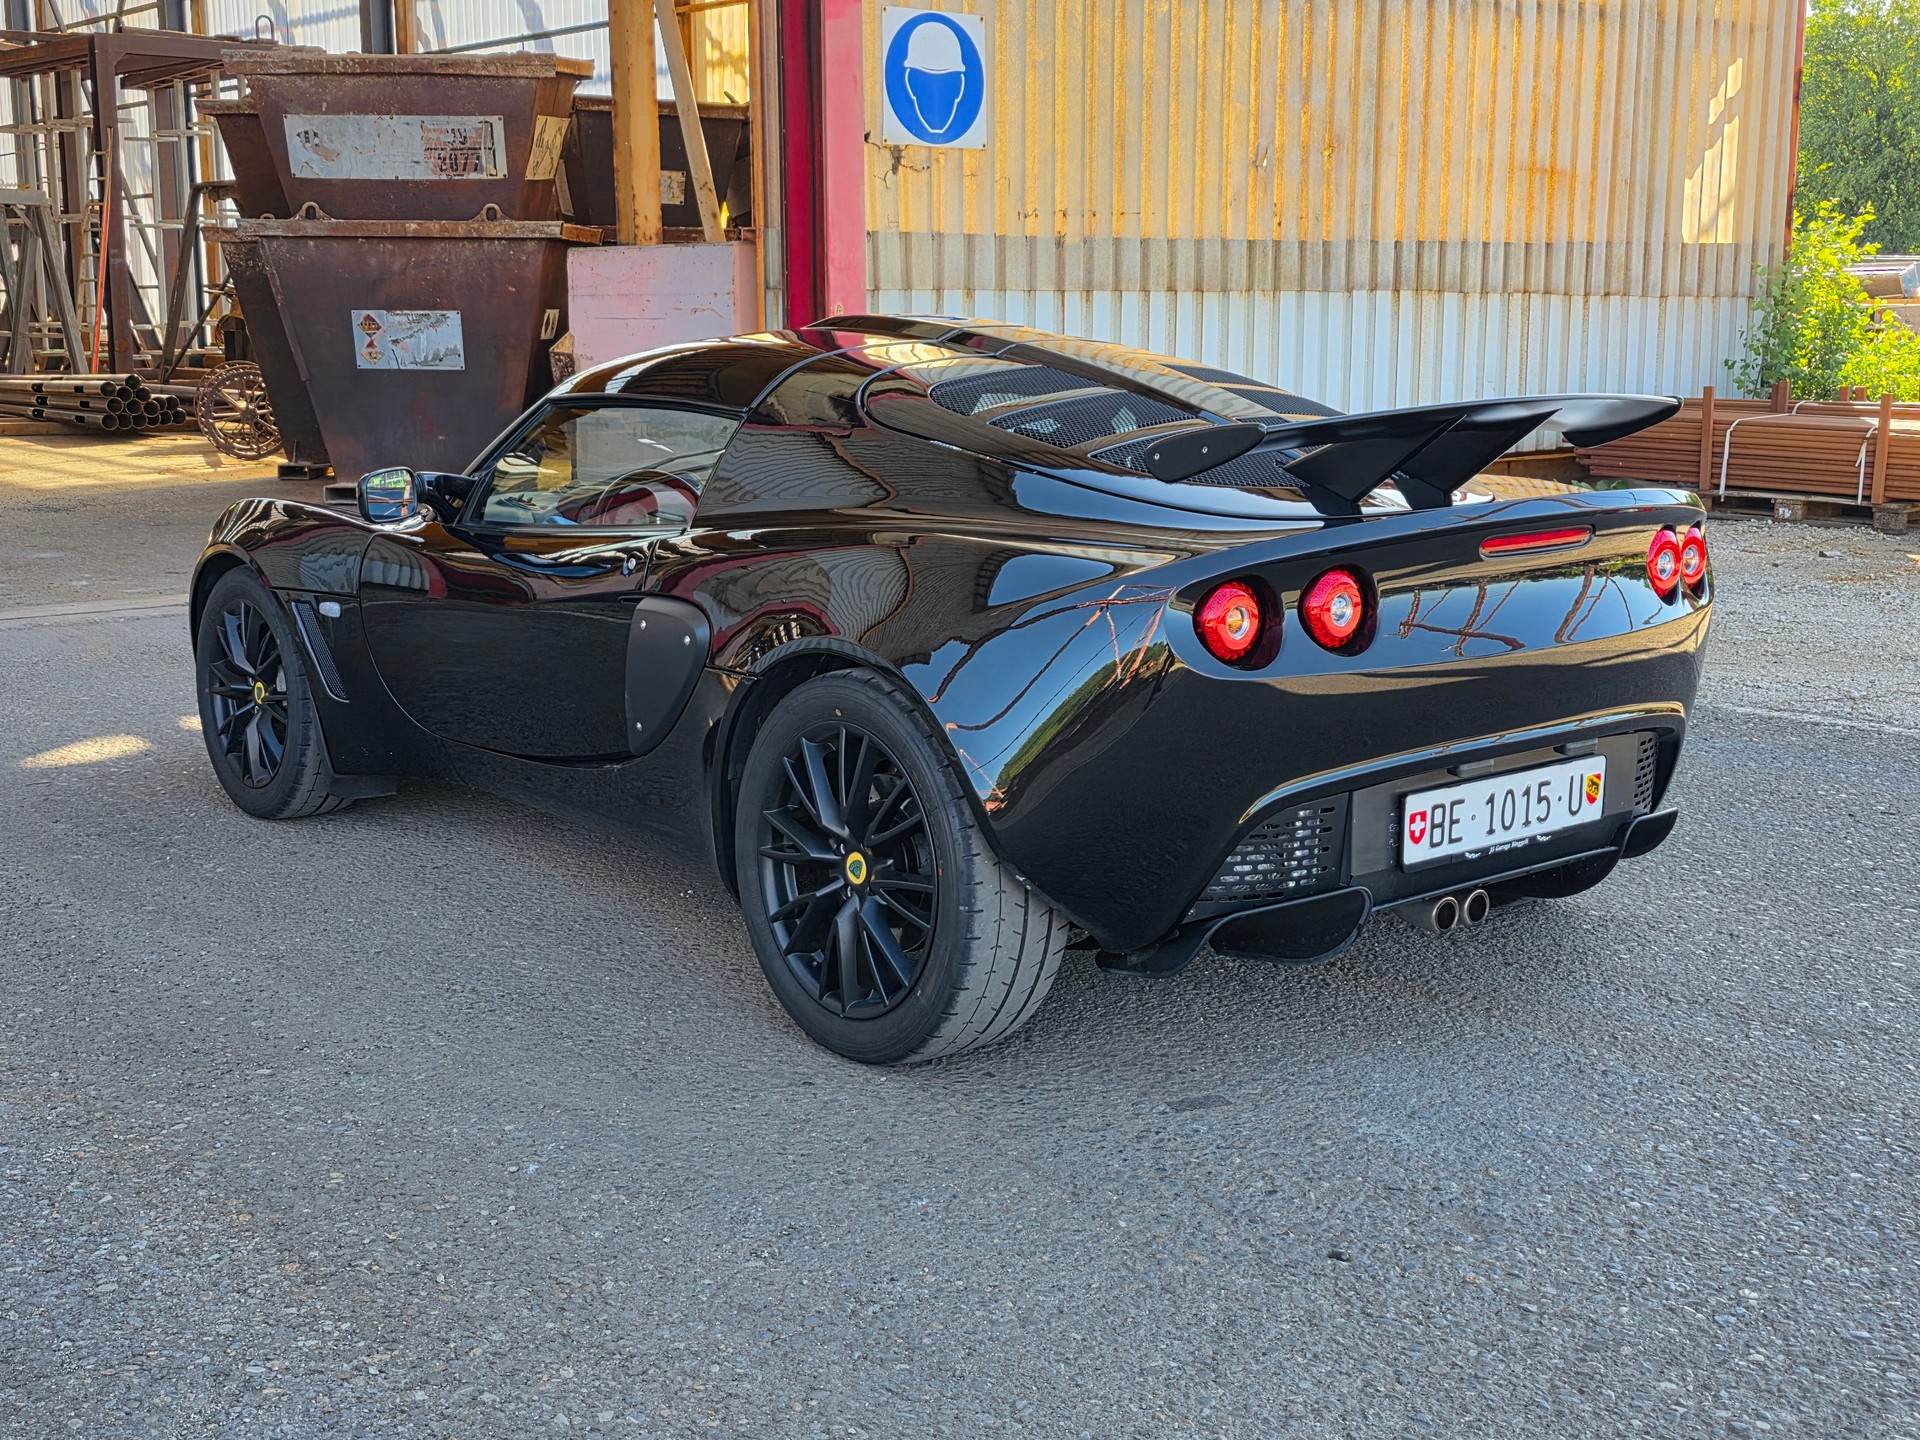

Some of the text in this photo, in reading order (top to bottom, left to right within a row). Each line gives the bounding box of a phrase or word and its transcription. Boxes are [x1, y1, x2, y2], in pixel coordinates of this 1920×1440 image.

[1429, 773, 1584, 848] BE 1015 U
